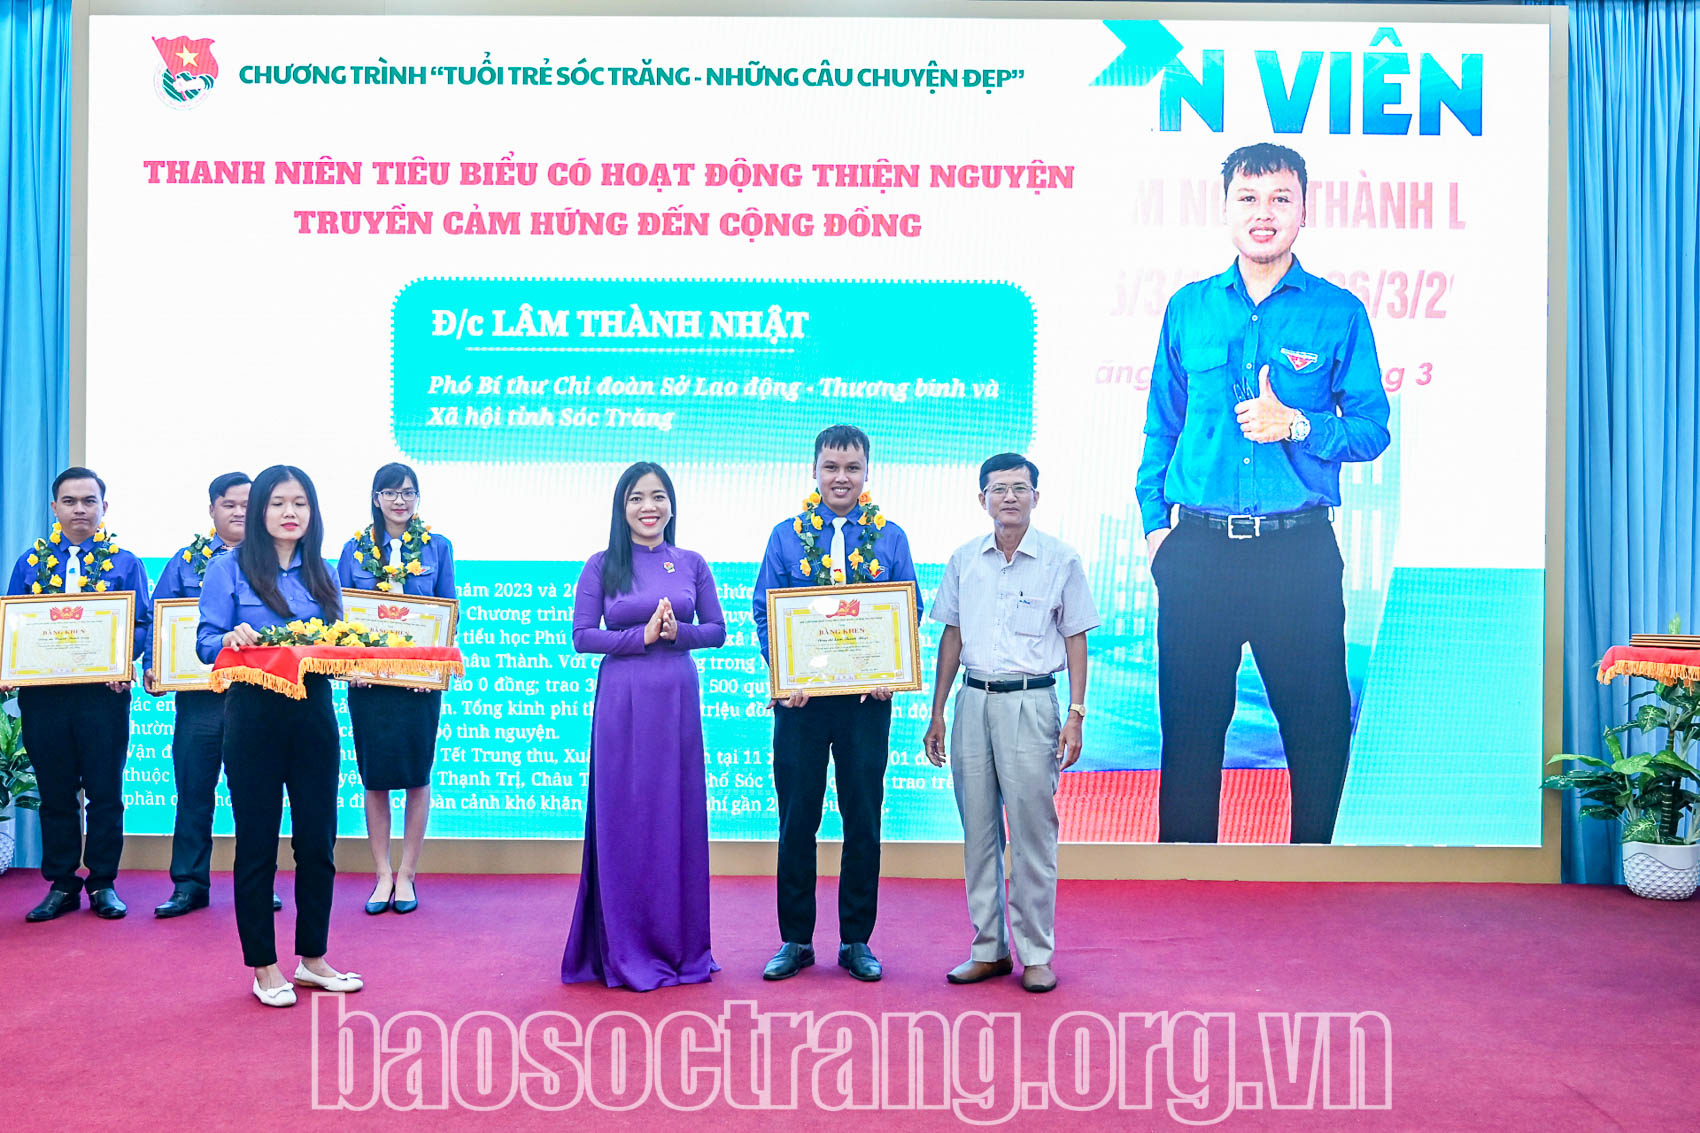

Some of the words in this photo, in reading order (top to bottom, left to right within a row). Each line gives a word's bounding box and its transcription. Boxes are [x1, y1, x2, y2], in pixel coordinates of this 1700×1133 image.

[240, 63, 347, 85] CHƯƠNG
[350, 57, 427, 85] TRÌNH
[508, 58, 552, 86] TRẺ
[556, 57, 604, 86] SÓC
[608, 58, 691, 86] TRĂNG
[706, 60, 799, 87] NHỮNG
[802, 59, 853, 87] CÂU
[857, 60, 959, 95] CHUYỆN
[1254, 27, 1484, 136] VIÊN
[144, 160, 265, 184] THANH
[275, 155, 362, 184] NIÊN
[372, 156, 451, 185] TIÊU
[460, 151, 538, 186] BIỂU
[547, 157, 591, 186] CÓ
[601, 163, 695, 192] HOẠT
[705, 158, 803, 193] ĐỘNG
[812, 158, 920, 194] THIỆN
[930, 160, 1075, 195] NGUYỆN
[1306, 169, 1433, 228] THÀNH
[293, 203, 433, 235] TRUYỀN
[443, 203, 520, 235] CẢM
[530, 207, 628, 236] HỨNG
[637, 204, 710, 236] ĐẾN
[720, 207, 815, 243] CỘNG
[824, 206, 922, 237] ĐỒNG
[432, 309, 484, 340] Đ/c
[492, 303, 570, 337] LÂM
[575, 304, 703, 339] THÀNH
[708, 304, 810, 345] NHẬT
[425, 372, 472, 397] Phó
[476, 374, 502, 397] Bí
[506, 374, 550, 396] thư
[553, 375, 592, 397] Chi
[596, 376, 656, 397] đoàn
[660, 374, 691, 397] Sở
[693, 376, 738, 397] Lao
[743, 376, 801, 402] động
[820, 376, 910, 403] Thương
[914, 377, 967, 398] bình
[971, 378, 1001, 400] và
[425, 405, 460, 427] Xã
[464, 405, 503, 430] hội
[558, 406, 600, 428] Sóc
[603, 406, 676, 432] Trăng
[494, 583, 532, 597] 2023
[538, 583, 557, 597] và
[466, 606, 531, 624] Chương
[463, 628, 495, 644] tiểu
[500, 629, 530, 647] học
[535, 630, 566, 644] Phú
[496, 653, 552, 668] Thành.
[557, 653, 588, 670] Với
[710, 656, 755, 674] trong
[479, 677, 488, 691] 0
[494, 676, 539, 695] đồng;
[546, 680, 579, 692] trao
[708, 677, 739, 693] 500
[508, 700, 544, 715] kinh
[551, 701, 578, 720] phí
[495, 724, 559, 743] nguyện.
[440, 747, 466, 762] Tết
[471, 748, 521, 766] Trung
[527, 748, 558, 764] thu,
[717, 749, 739, 767] tại
[743, 749, 762, 765] 11
[124, 766, 170, 785] thuộc
[437, 771, 491, 788] Thạnh
[496, 771, 525, 789] Trị,
[532, 772, 573, 786] Châu
[735, 772, 764, 788] Sóc
[891, 776, 926, 790] trao
[124, 789, 166, 809] phần
[460, 792, 500, 810] cảnh
[503, 794, 537, 810] khó
[540, 794, 583, 811] khăn
[731, 795, 762, 816] gần
